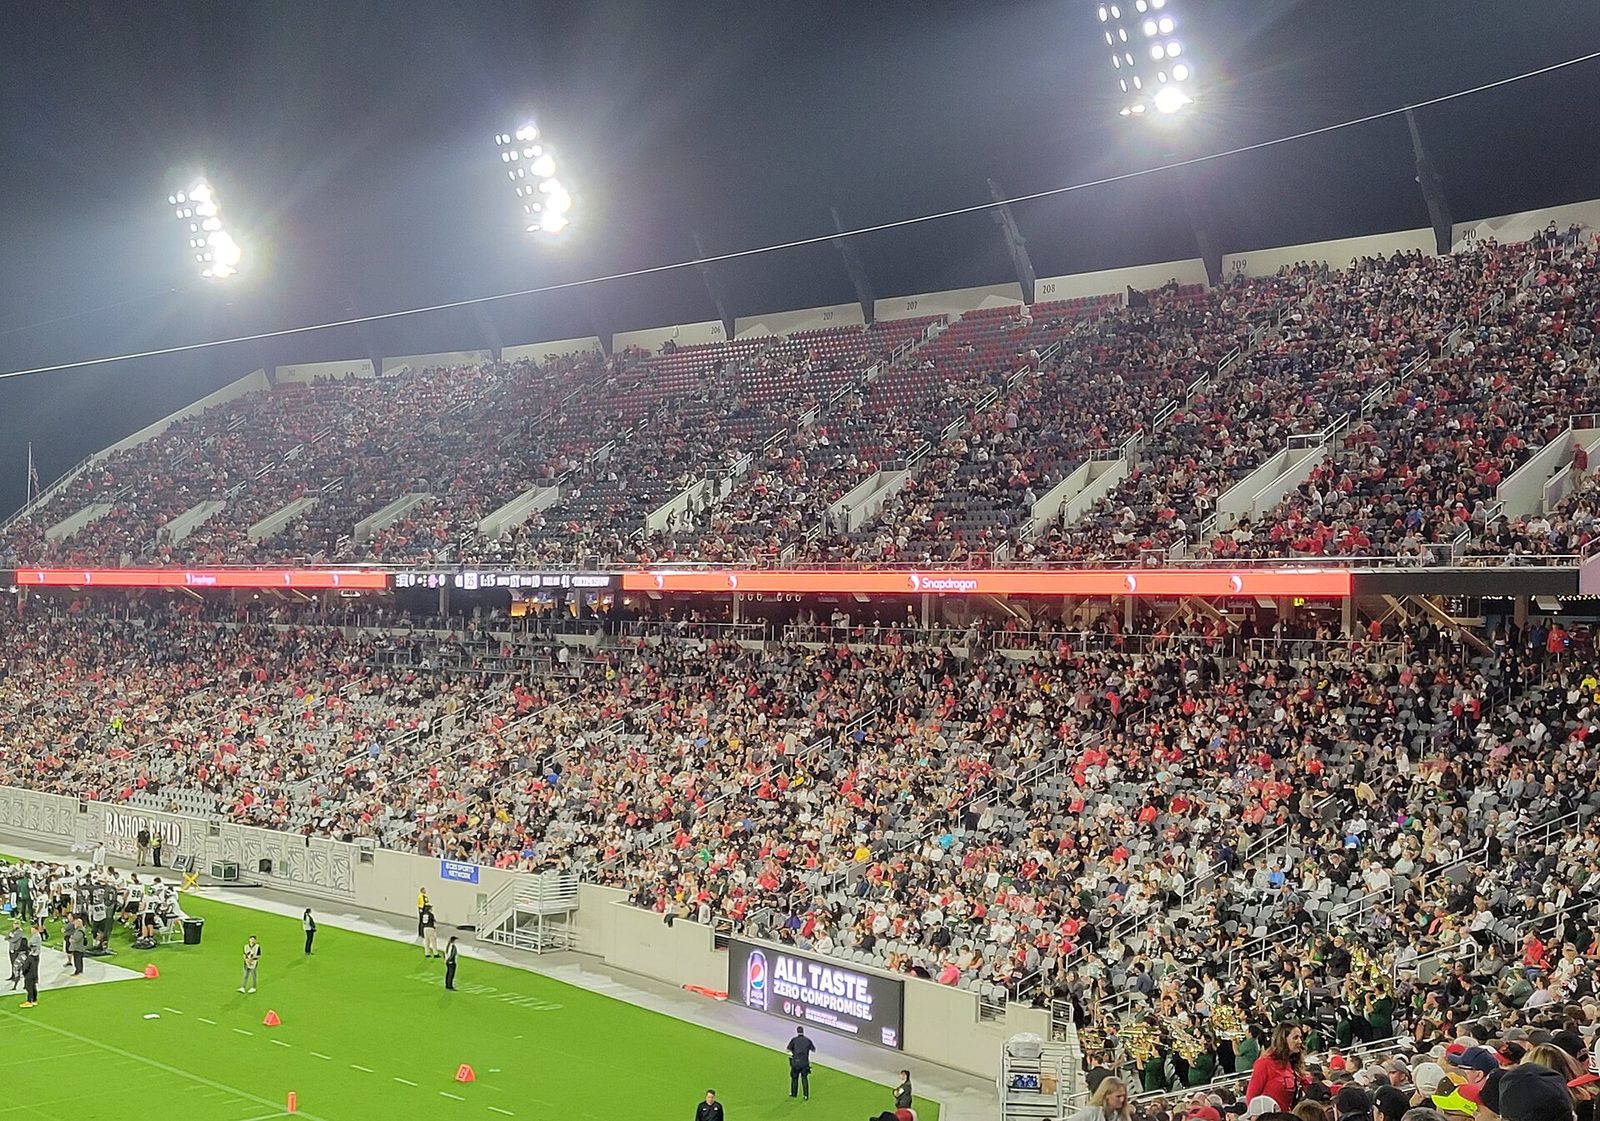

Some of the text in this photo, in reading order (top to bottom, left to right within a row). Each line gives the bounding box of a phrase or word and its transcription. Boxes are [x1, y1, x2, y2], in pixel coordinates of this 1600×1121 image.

[1462, 228, 1477, 240] 210
[1231, 259, 1247, 271] 209
[1042, 284, 1056, 295] 208
[906, 301, 918, 311] 207
[823, 311, 834, 321] 207
[921, 576, 977, 592] Snapdragon
[773, 955, 873, 1005] ALL TASTE.
[773, 980, 800, 1001] ZERO
[800, 990, 873, 1021] COMPROMISE.
